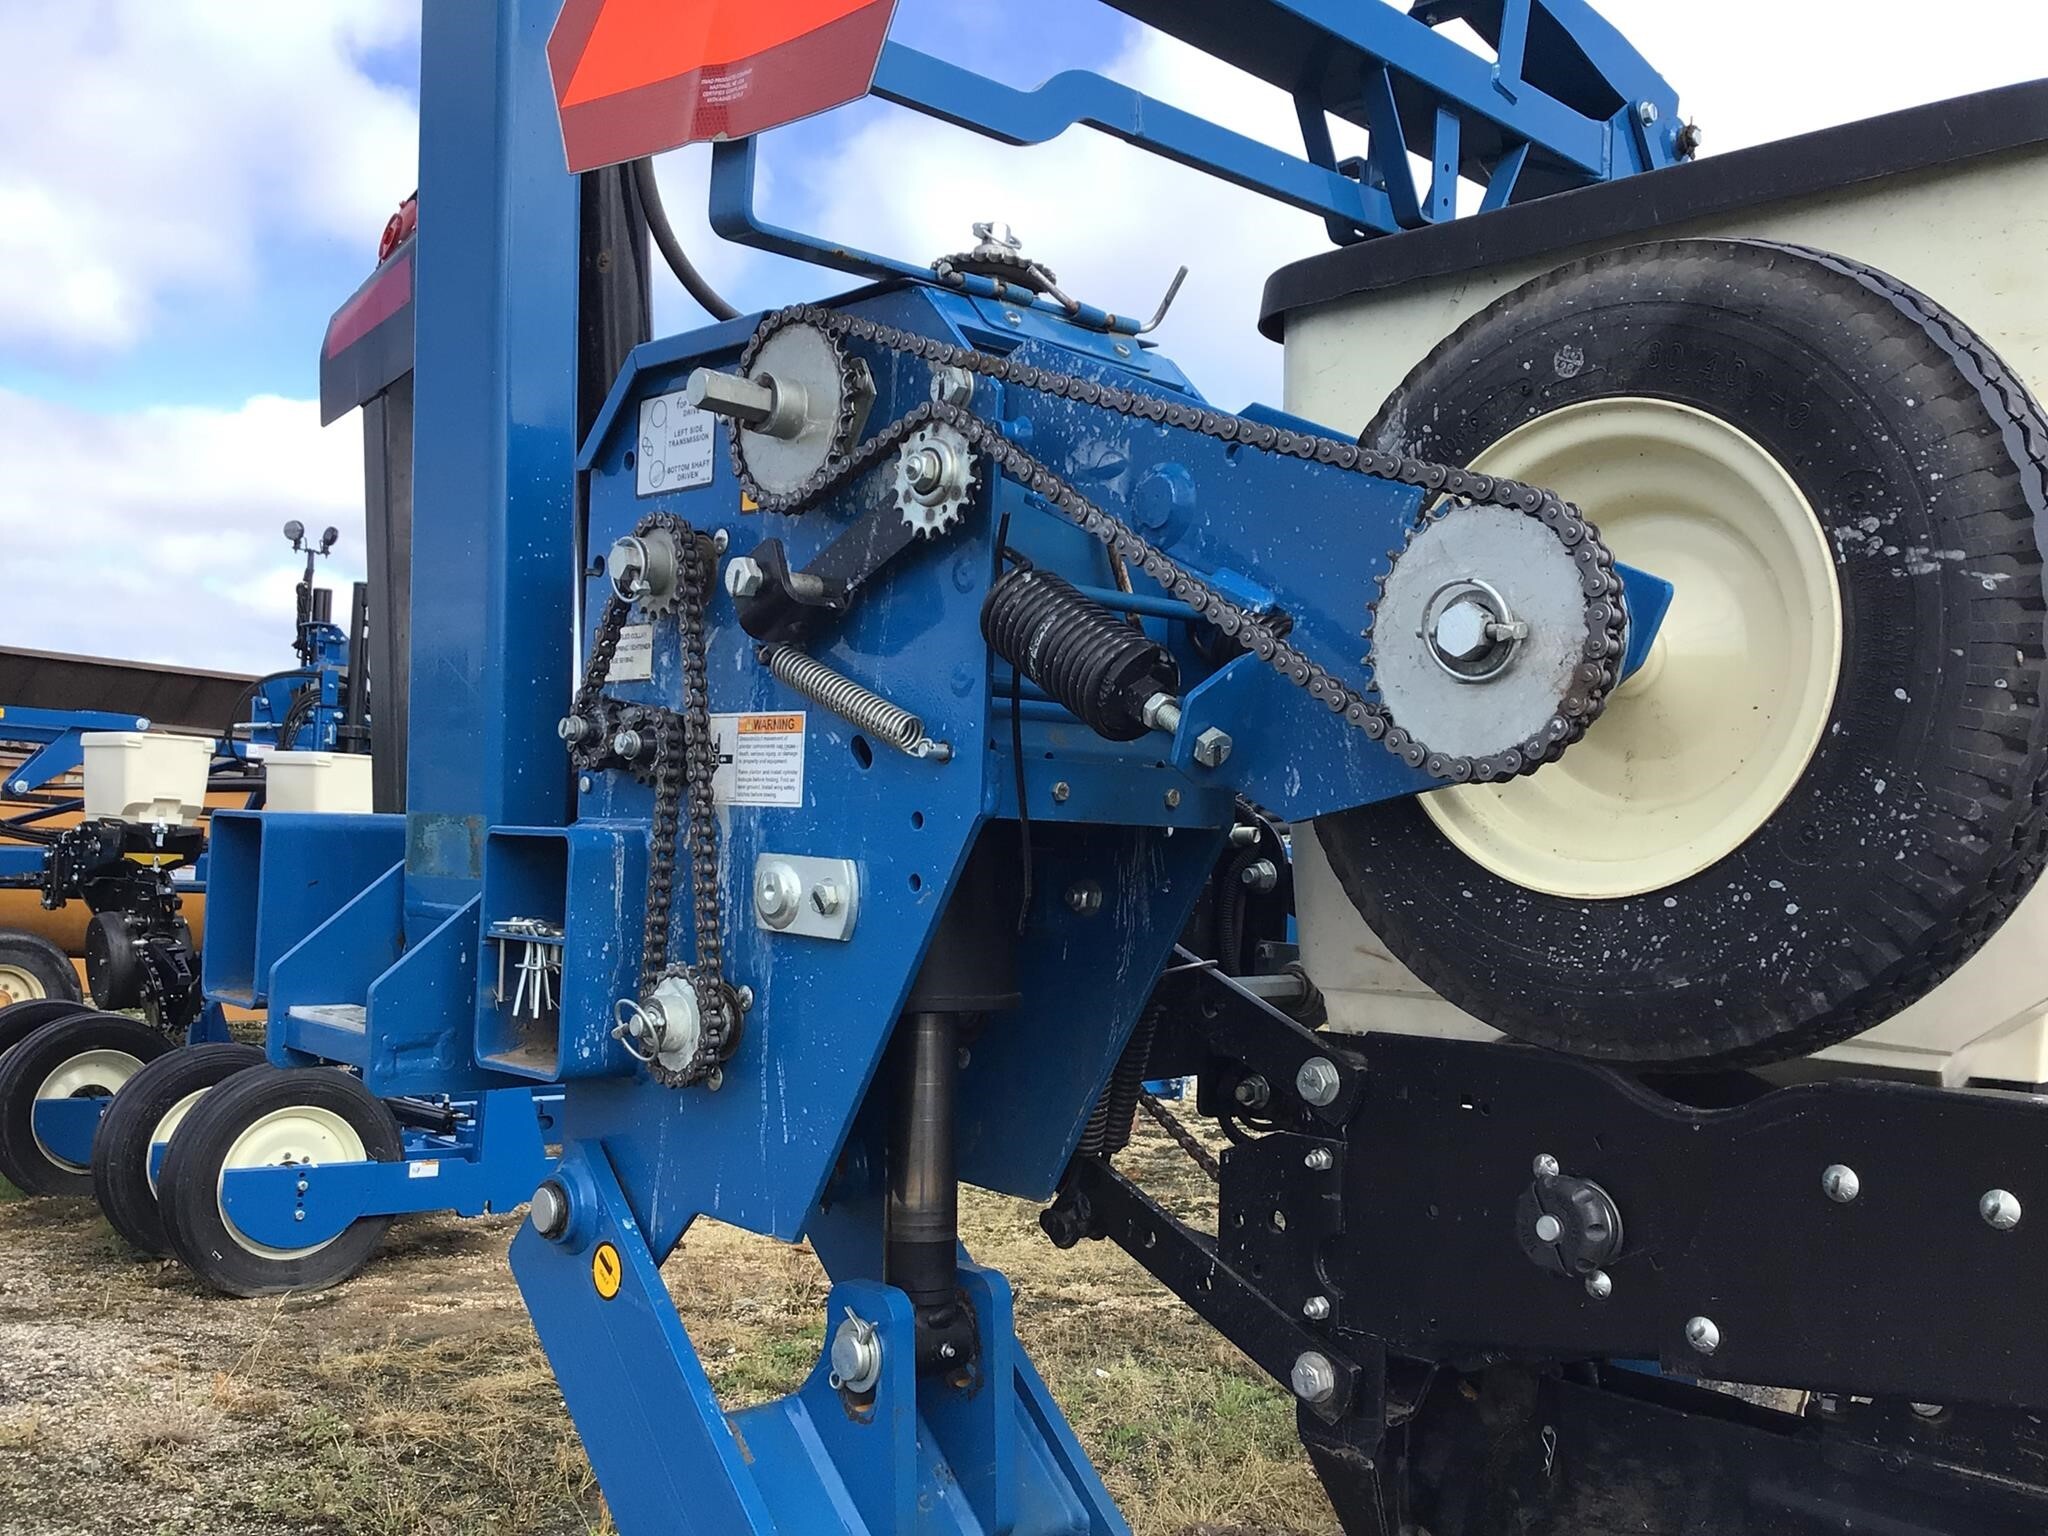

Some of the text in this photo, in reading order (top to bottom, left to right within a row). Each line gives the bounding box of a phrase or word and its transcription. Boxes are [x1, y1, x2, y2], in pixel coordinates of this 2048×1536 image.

[674, 425, 704, 438] LEFT SIDE
[669, 433, 710, 448] TRANSMISSION
[667, 460, 710, 474] BOTTOM SHAFT
[677, 472, 698, 482] DRIVEN
[754, 718, 794, 730] WARNING
